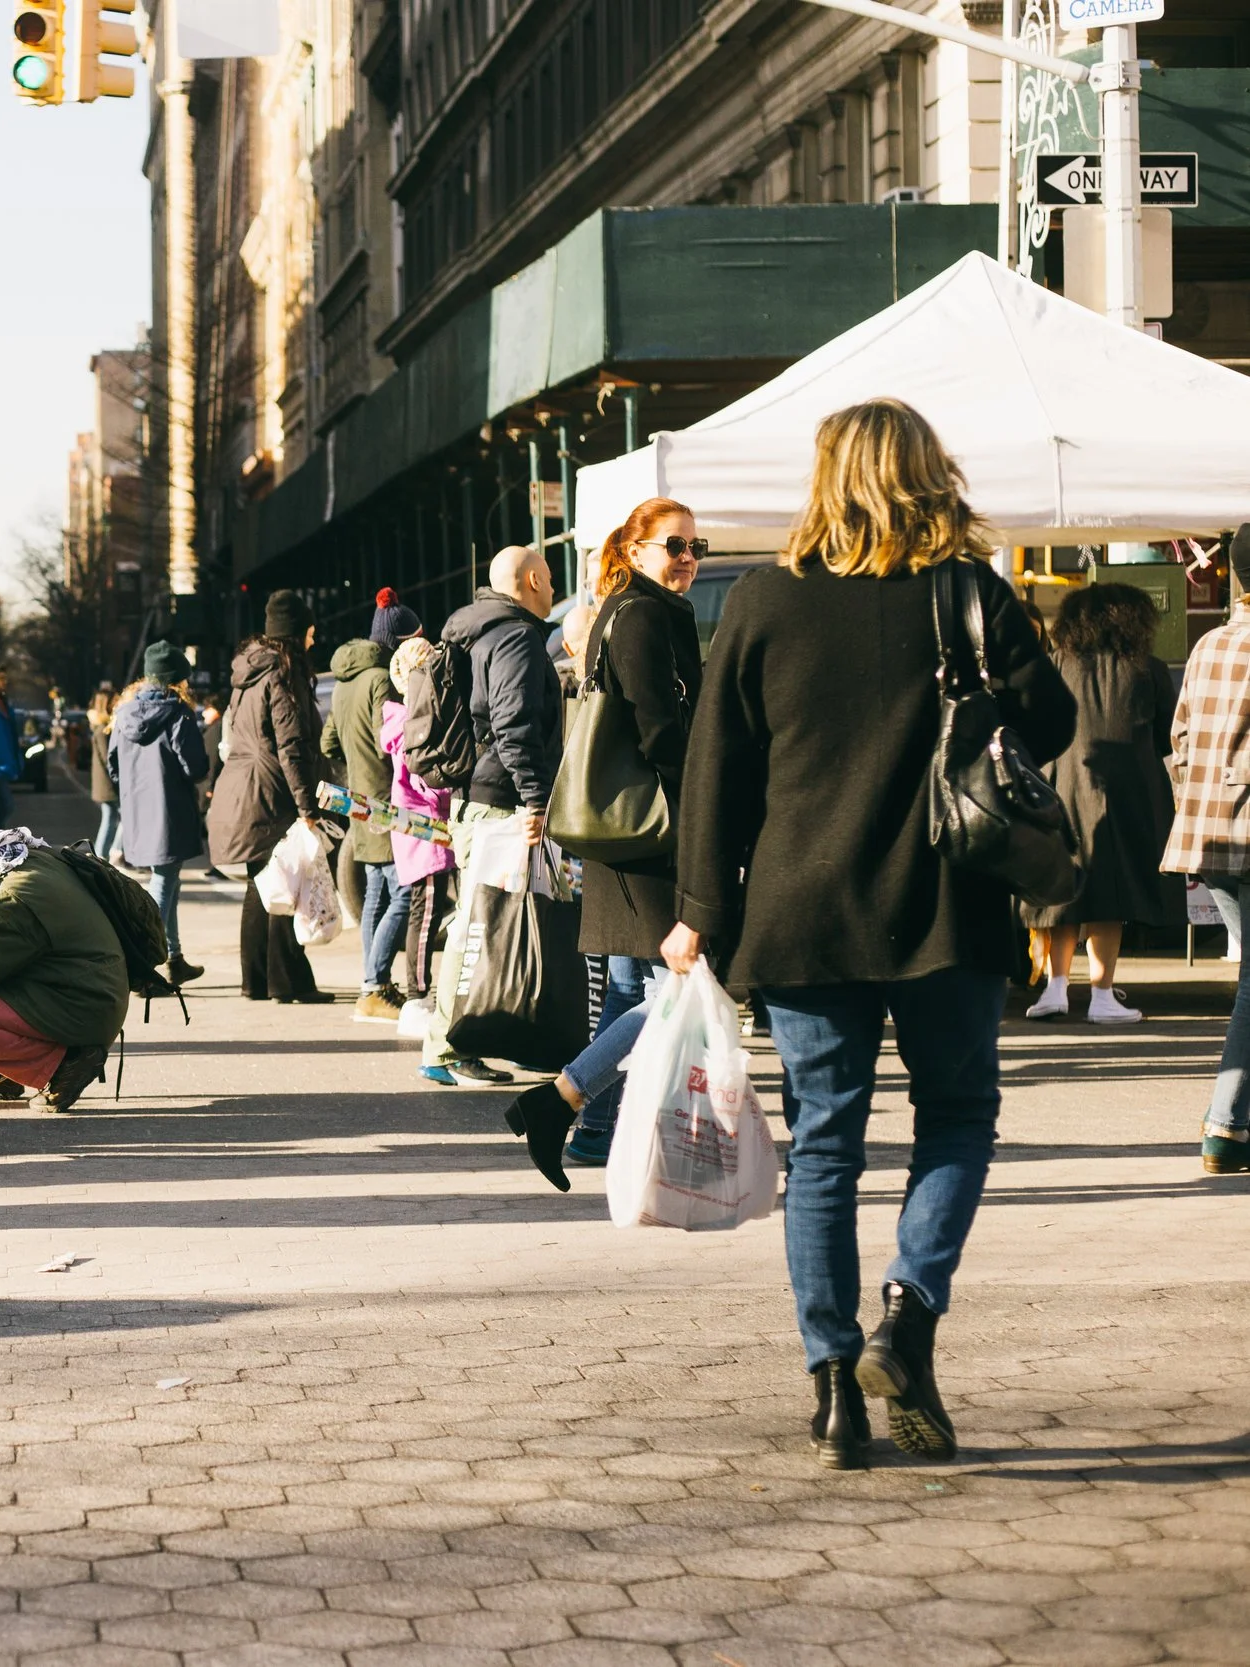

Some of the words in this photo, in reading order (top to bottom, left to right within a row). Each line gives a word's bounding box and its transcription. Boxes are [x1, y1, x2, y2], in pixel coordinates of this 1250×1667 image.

[1069, 0, 1154, 19] CAMERA
[1067, 171, 1102, 189] ON
[456, 922, 486, 996] URBAN
[584, 953, 604, 1043] UTFITT
